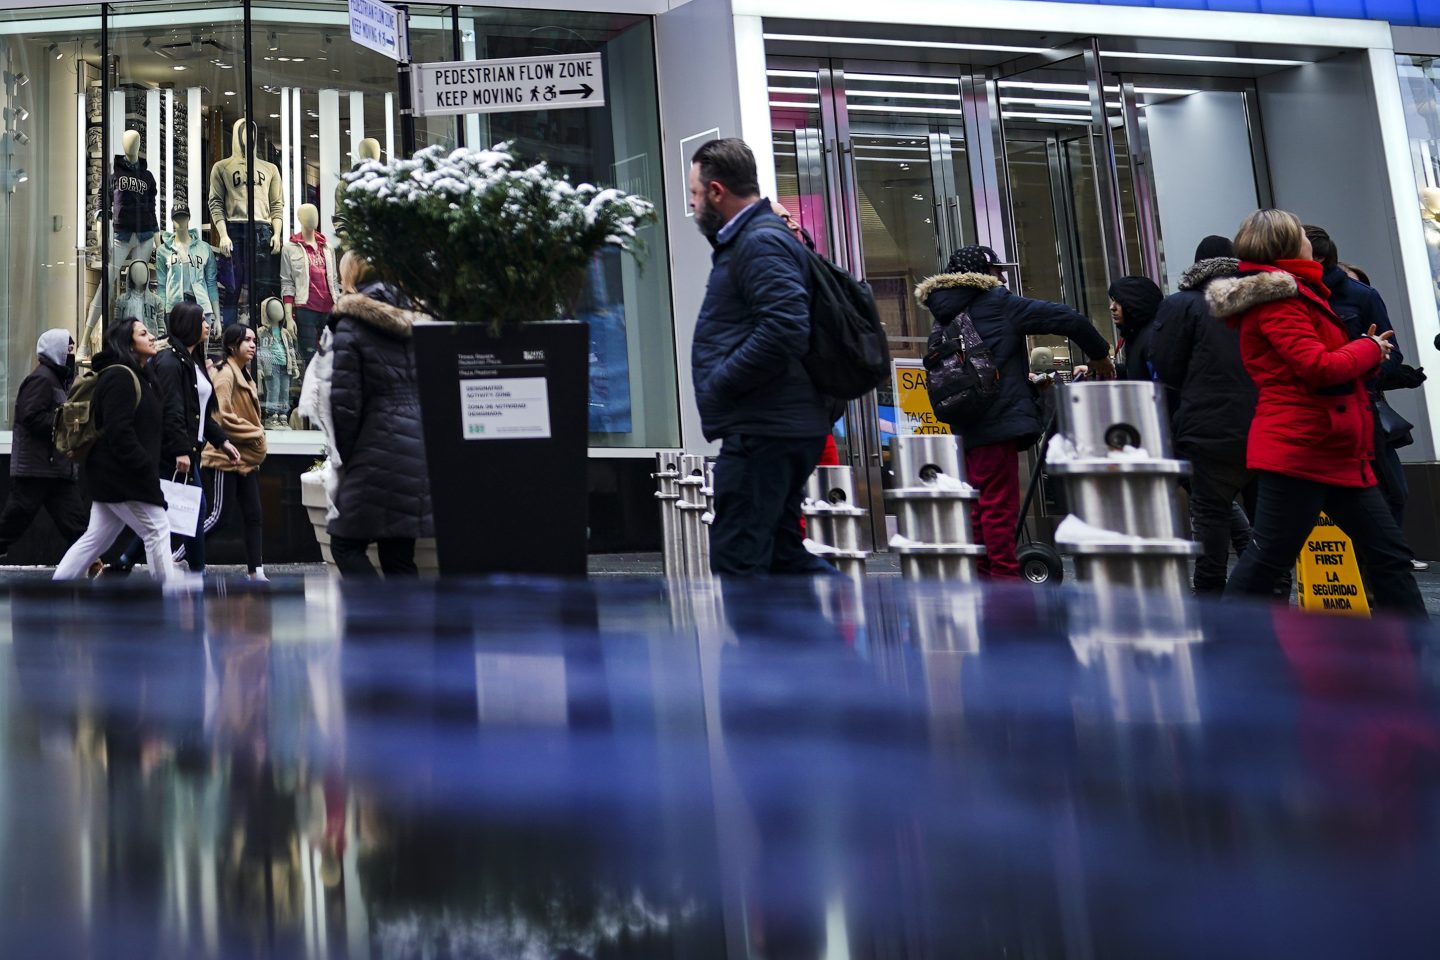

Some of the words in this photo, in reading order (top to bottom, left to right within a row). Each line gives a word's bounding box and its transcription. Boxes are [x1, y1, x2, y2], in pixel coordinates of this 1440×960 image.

[374, 5, 385, 25] FLOW
[384, 11, 395, 30] ZONE
[351, 16, 362, 35] KEEP
[362, 23, 378, 43] MOVING
[435, 66, 516, 86] PEDESTRIAN
[519, 63, 554, 81] FLOW
[558, 61, 594, 79] ZONE
[436, 90, 468, 107] KEEP
[473, 87, 523, 105] MOVING
[117, 175, 149, 195] GAP
[904, 411, 933, 424] TAKE
[912, 426, 948, 435] EXTRA
[1307, 540, 1347, 552] SAFETY
[1314, 553, 1344, 565] FIRST
[1325, 570, 1340, 583] LA
[1311, 583, 1358, 596] SEGURIDAD
[1321, 597, 1353, 610] MANDA
